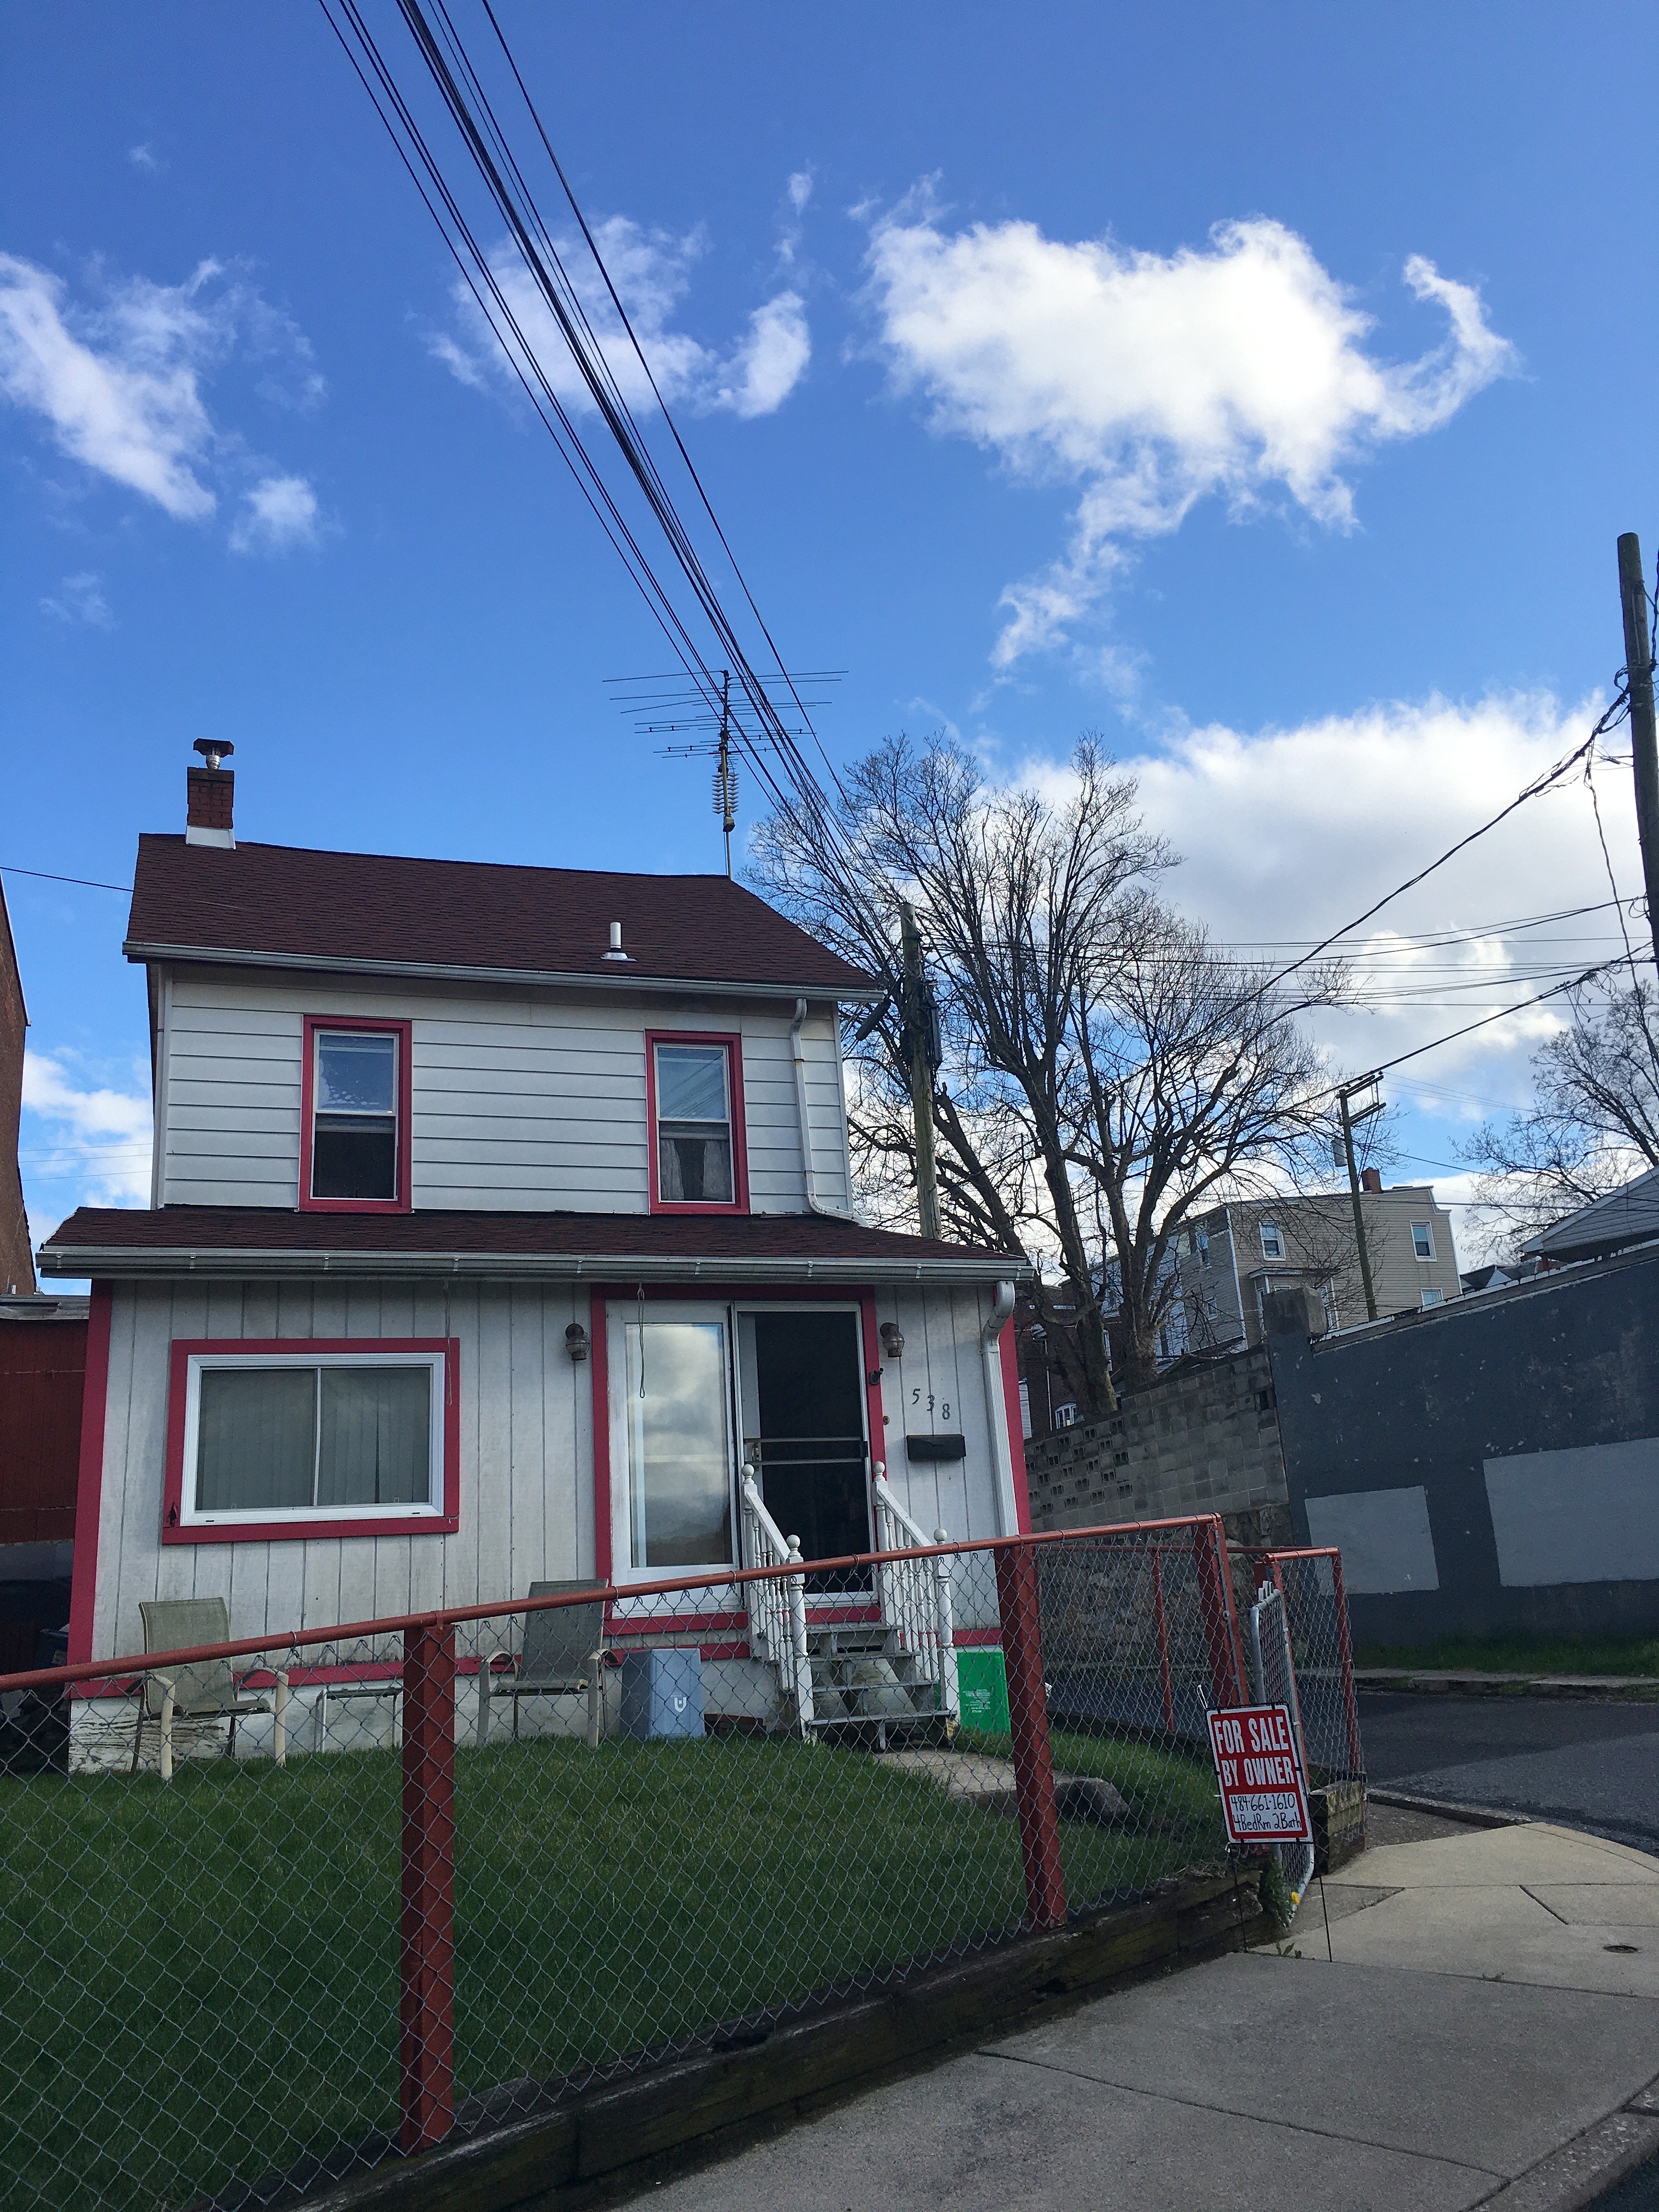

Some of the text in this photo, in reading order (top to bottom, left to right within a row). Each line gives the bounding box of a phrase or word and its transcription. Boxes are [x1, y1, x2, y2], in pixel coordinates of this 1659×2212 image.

[912, 1388, 950, 1420] 538
[1214, 1716, 1289, 1754] FOR SALE
[1221, 1757, 1295, 1786] BY OWNER
[1231, 1793, 1295, 1812] 484-661-1610
